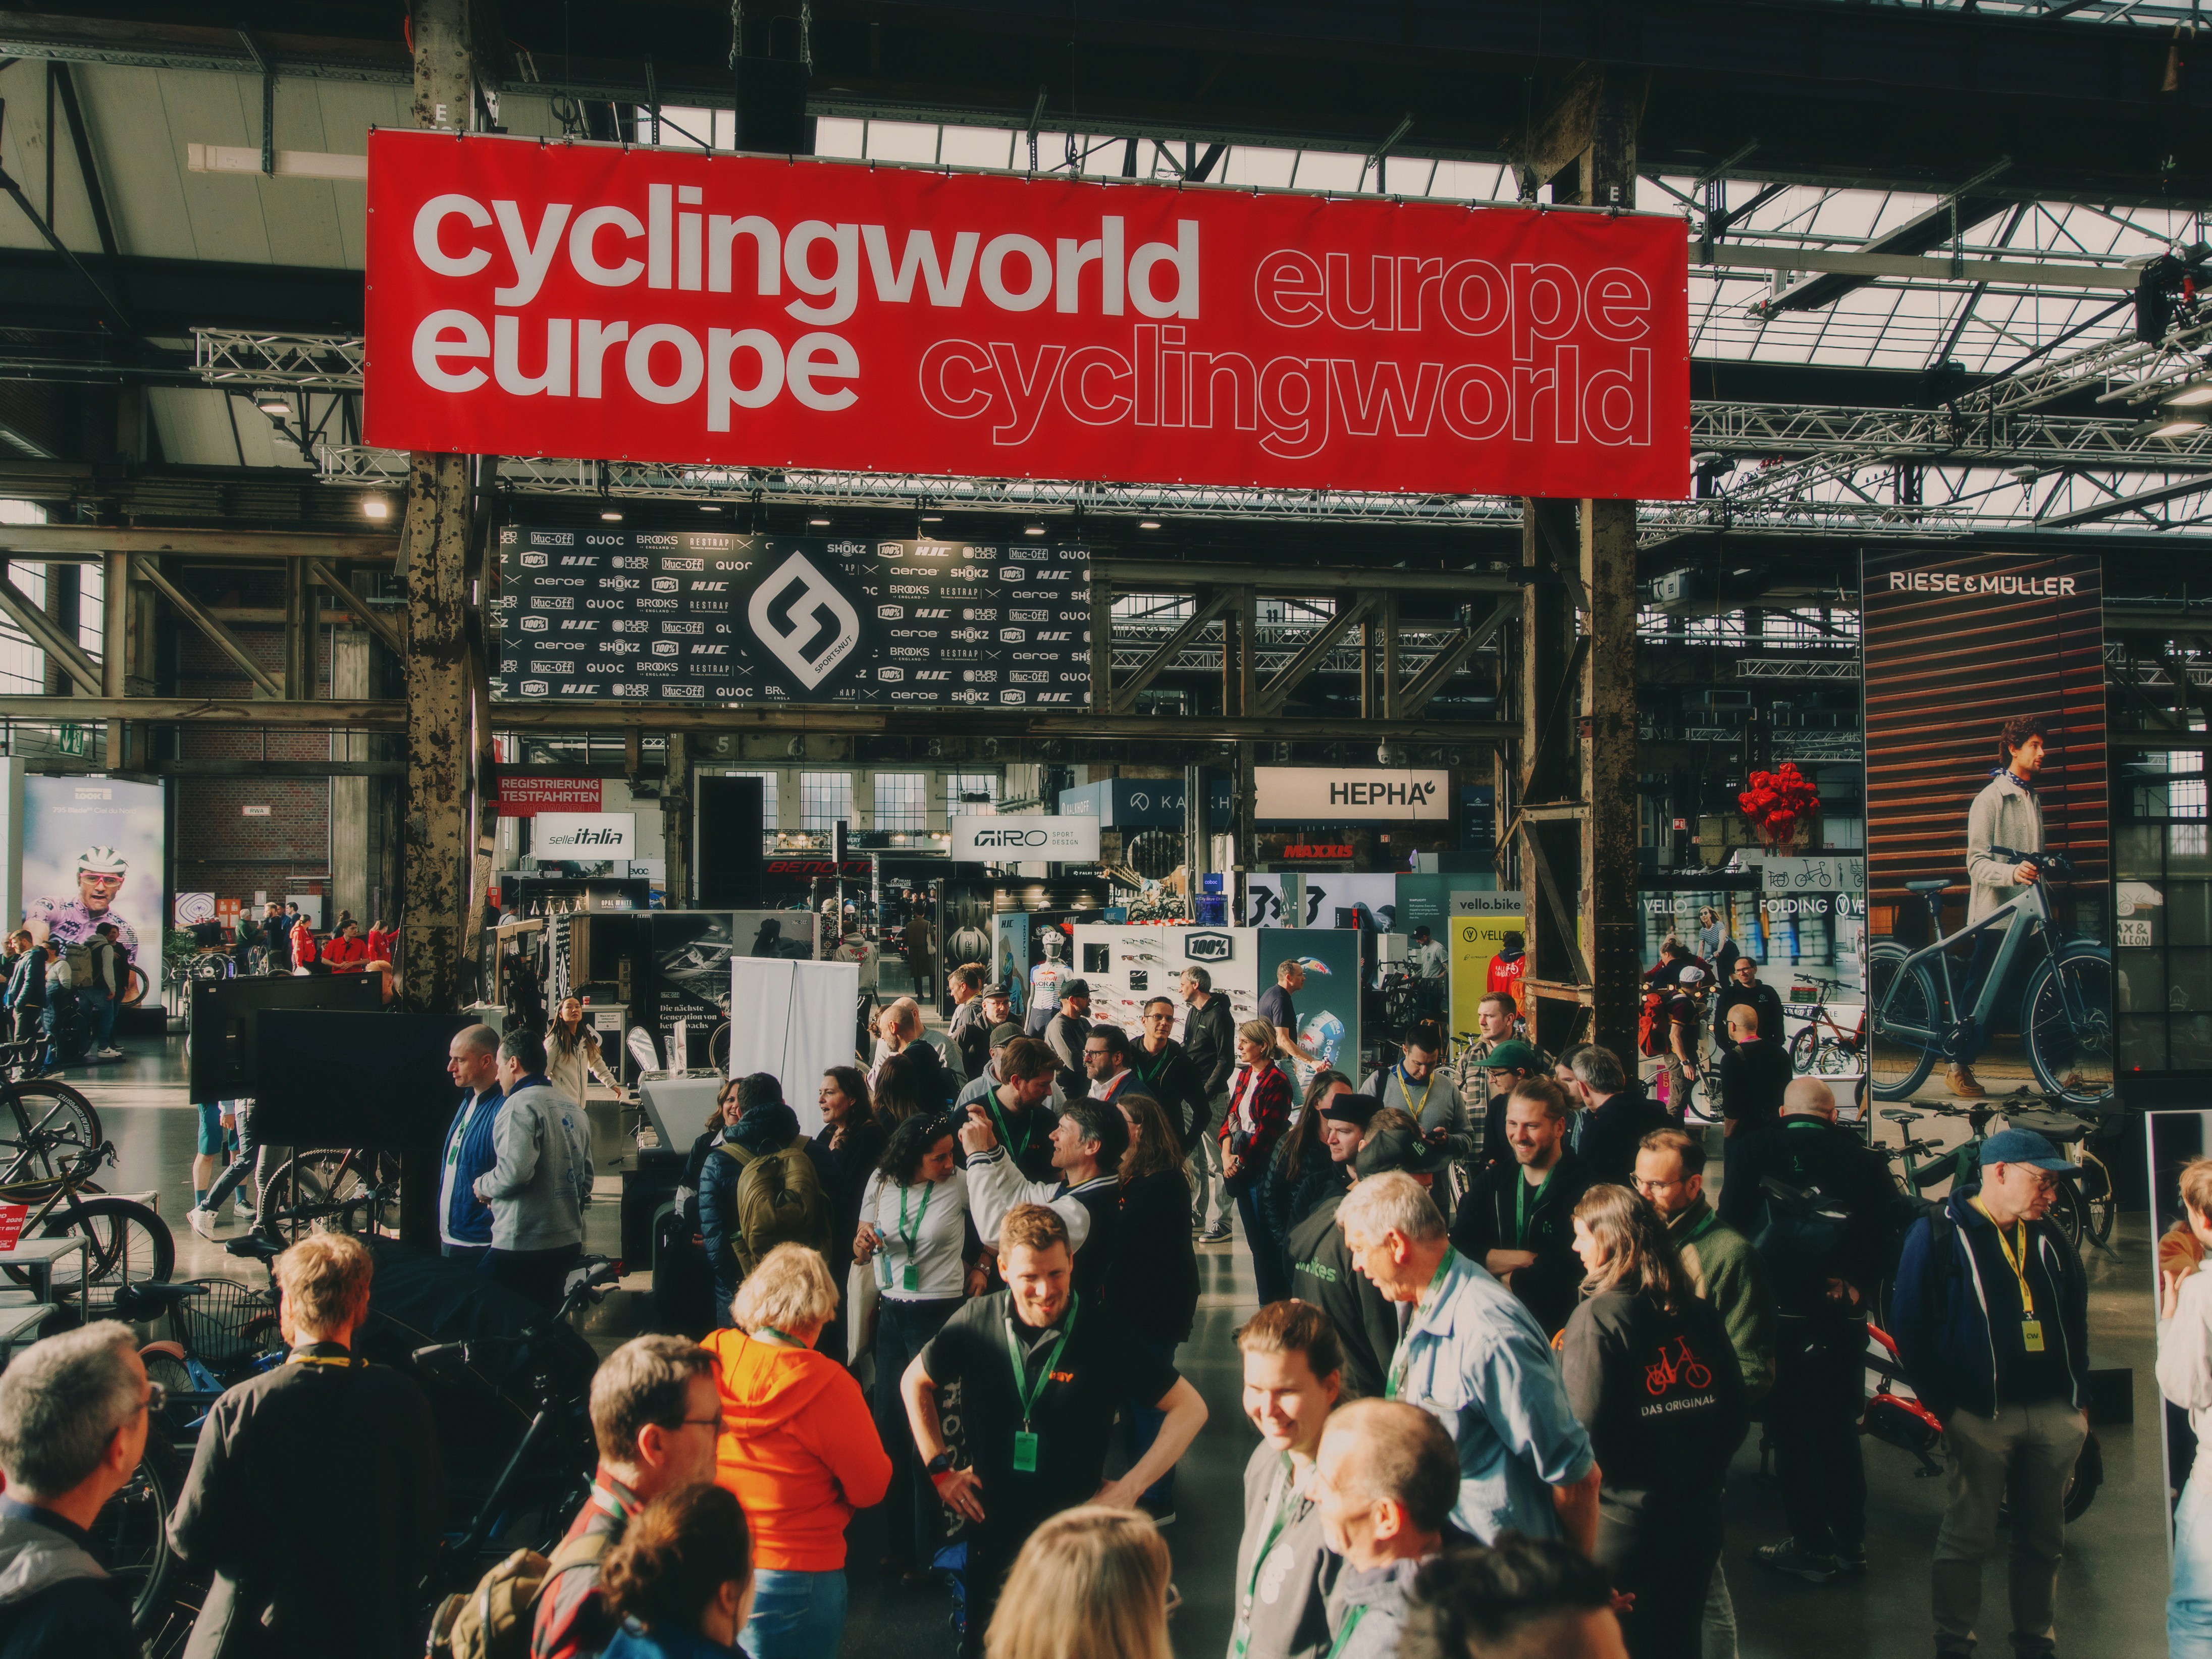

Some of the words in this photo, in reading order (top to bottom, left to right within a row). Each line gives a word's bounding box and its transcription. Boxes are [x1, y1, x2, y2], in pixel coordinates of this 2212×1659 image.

[436, 104, 446, 121] E
[1610, 186, 1619, 201] E
[413, 184, 1199, 326] cyclingworld
[1255, 249, 1650, 361] europe
[412, 309, 859, 432] europe
[919, 324, 1651, 459] cyclingworld
[533, 534, 571, 544] Muc-Off
[586, 536, 623, 545] QUOC
[637, 535, 678, 545] BROOKS
[690, 538, 729, 547] RESTRAP
[827, 543, 866, 555] SHOKZ
[881, 546, 900, 555] 100%
[915, 547, 952, 556] HJC
[1011, 550, 1046, 559] Muc-Off
[524, 555, 544, 564] 100%
[561, 556, 599, 566] HJC
[664, 560, 702, 569] Muc-Off
[890, 567, 937, 575] aeroe
[951, 567, 988, 579] SHOKZ
[1004, 570, 1021, 578] 100%
[1036, 571, 1072, 579] HJC
[599, 577, 640, 590] SHOKZ
[655, 580, 675, 590] 100%
[691, 581, 729, 591] HJC
[1890, 572, 1960, 592] RIESE
[1964, 577, 1977, 592] &
[1980, 575, 2076, 596] MÜLLER
[890, 585, 929, 594] BROOKS
[940, 587, 978, 596] RESTRAP
[533, 599, 572, 608] Muc-Off
[587, 600, 624, 609] QUOC
[637, 599, 678, 608] BROOKS
[881, 608, 900, 617] 100%
[915, 609, 951, 618] HJC
[1011, 611, 1046, 620] Muc-Off
[524, 620, 545, 628] 100%
[561, 620, 600, 630] HJC
[664, 623, 702, 632] Muc-Off
[951, 629, 988, 640] SHOKZ
[1004, 631, 1021, 639] 100%
[1037, 632, 1072, 640] HJC
[599, 641, 640, 653] SHOKZ
[656, 644, 675, 653] 100%
[691, 645, 729, 654] HJC
[890, 647, 929, 656] BROOKS
[815, 635, 852, 673] SPORTSNUT
[941, 650, 978, 658] RESTRAP
[533, 663, 572, 672] Muc-Off
[587, 663, 624, 673] QUOC
[637, 662, 678, 671] BROOKS
[691, 665, 729, 673] RESTRAP
[881, 670, 900, 679] 100%
[916, 671, 952, 680] HJC
[1012, 673, 1047, 681] Muc-Off
[524, 684, 545, 693] 100%
[561, 684, 600, 693] HJC
[664, 687, 702, 696] Muc-Off
[716, 687, 753, 697] QUOC
[952, 691, 989, 702] SHOKZ
[1004, 693, 1022, 701] 100%
[1037, 693, 1072, 702] HJC
[716, 736, 729, 753] 5
[502, 779, 599, 789] REGISTRIERUNG
[501, 791, 599, 802] TESTFAHRTEN
[1331, 782, 1428, 805] HEPHA
[1066, 801, 1089, 815] KALKHOFF
[974, 830, 1047, 846] GIRO
[1284, 845, 1353, 858] MAXXIS
[1460, 898, 1520, 910] vello.bike
[1643, 899, 1687, 914] VELLO
[1759, 899, 1827, 914] FOLDING
[1001, 920, 1014, 928] HJC
[2137, 923, 2148, 934] &
[1192, 939, 1228, 955] 100%
[57, 1093, 84, 1117] COMPOSITES
[81, 1117, 91, 1133] AHEAD
[1642, 1404, 1662, 1416] DAS
[1665, 1394, 1715, 1411] ORIGINAL
